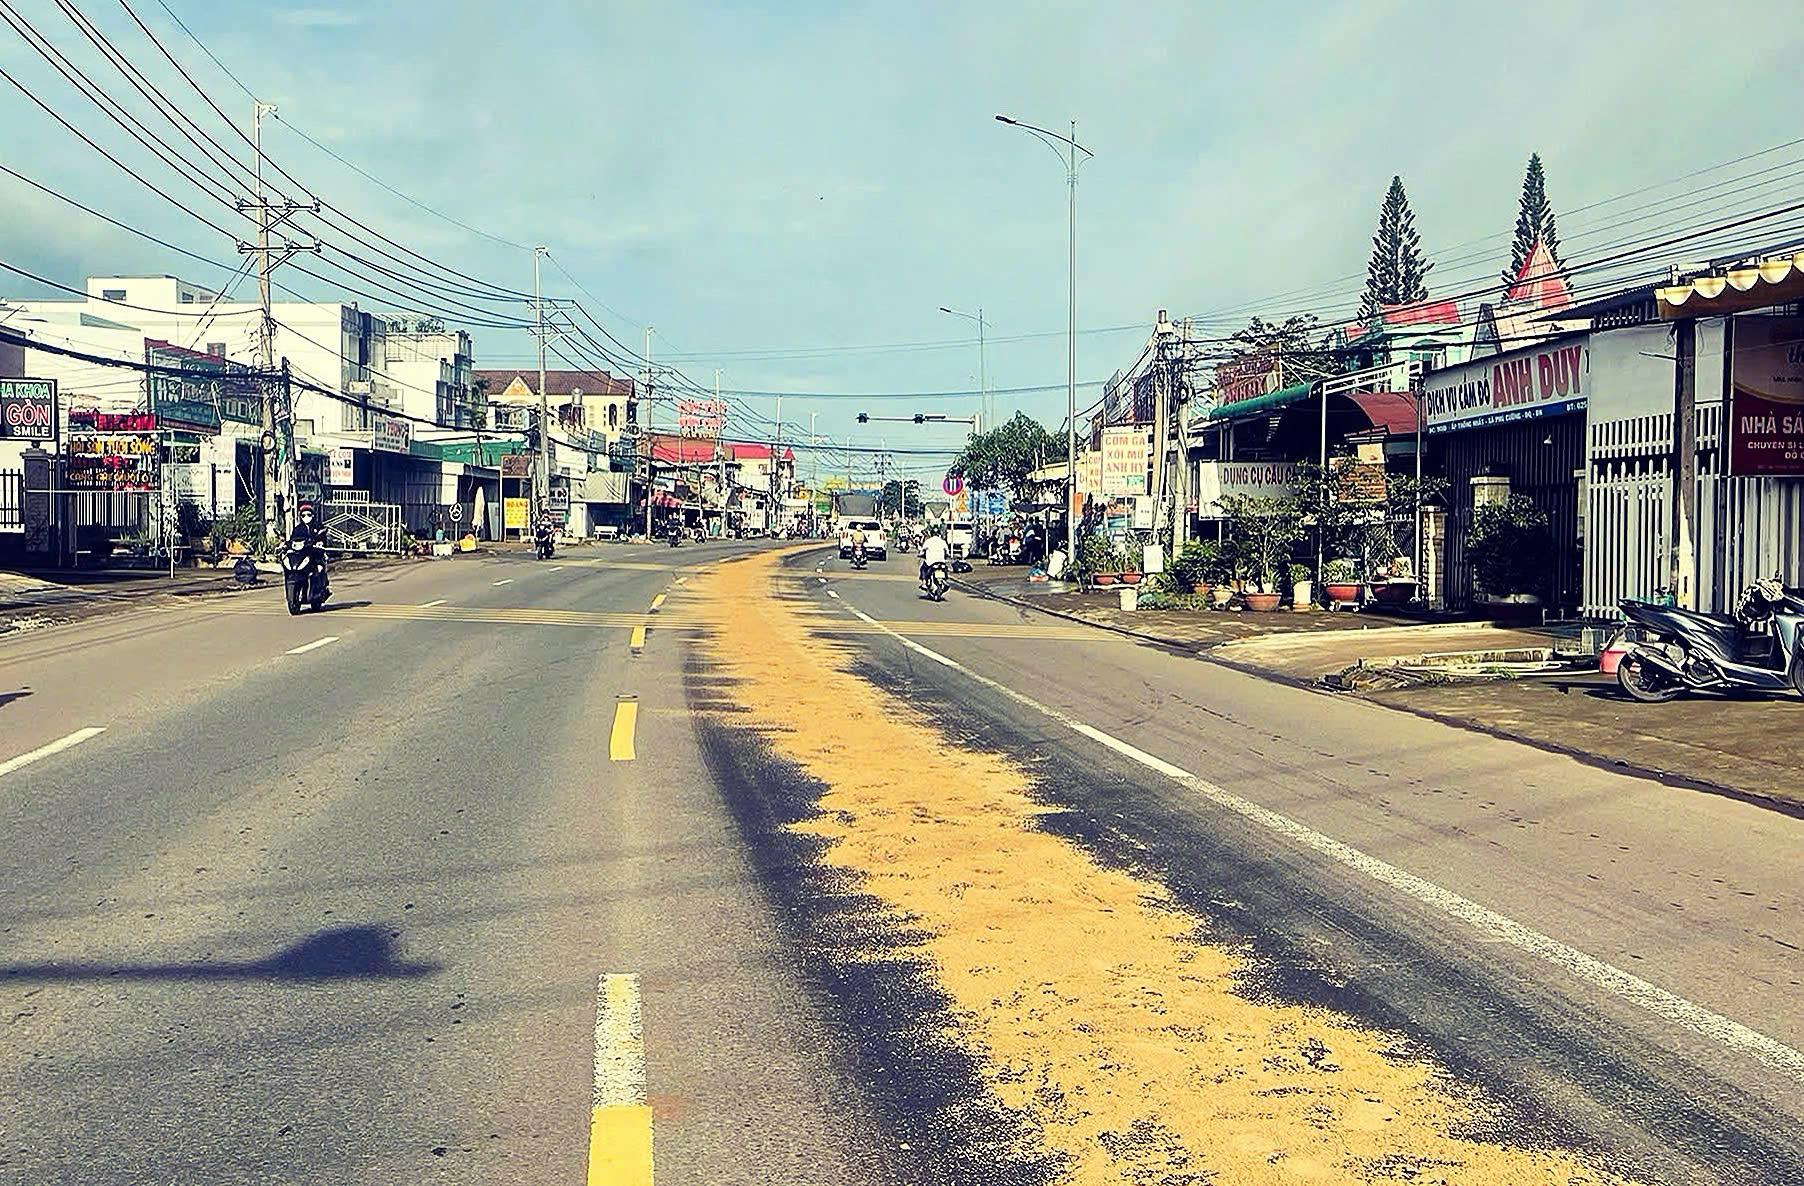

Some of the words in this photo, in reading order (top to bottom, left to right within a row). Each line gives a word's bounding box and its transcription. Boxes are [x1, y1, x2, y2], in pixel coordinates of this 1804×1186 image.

[1493, 356, 1535, 408] ANH
[1537, 344, 1582, 401] DUY
[15, 383, 50, 400] KHOA
[6, 398, 50, 426] GÒN
[1741, 410, 1777, 434] NHÀ
[1782, 411, 1804, 434] SÁ
[13, 426, 50, 437] SMILE
[1105, 462, 1128, 473] ANH
[1223, 467, 1249, 488] DỤNG
[1251, 466, 1264, 488] CỤ
